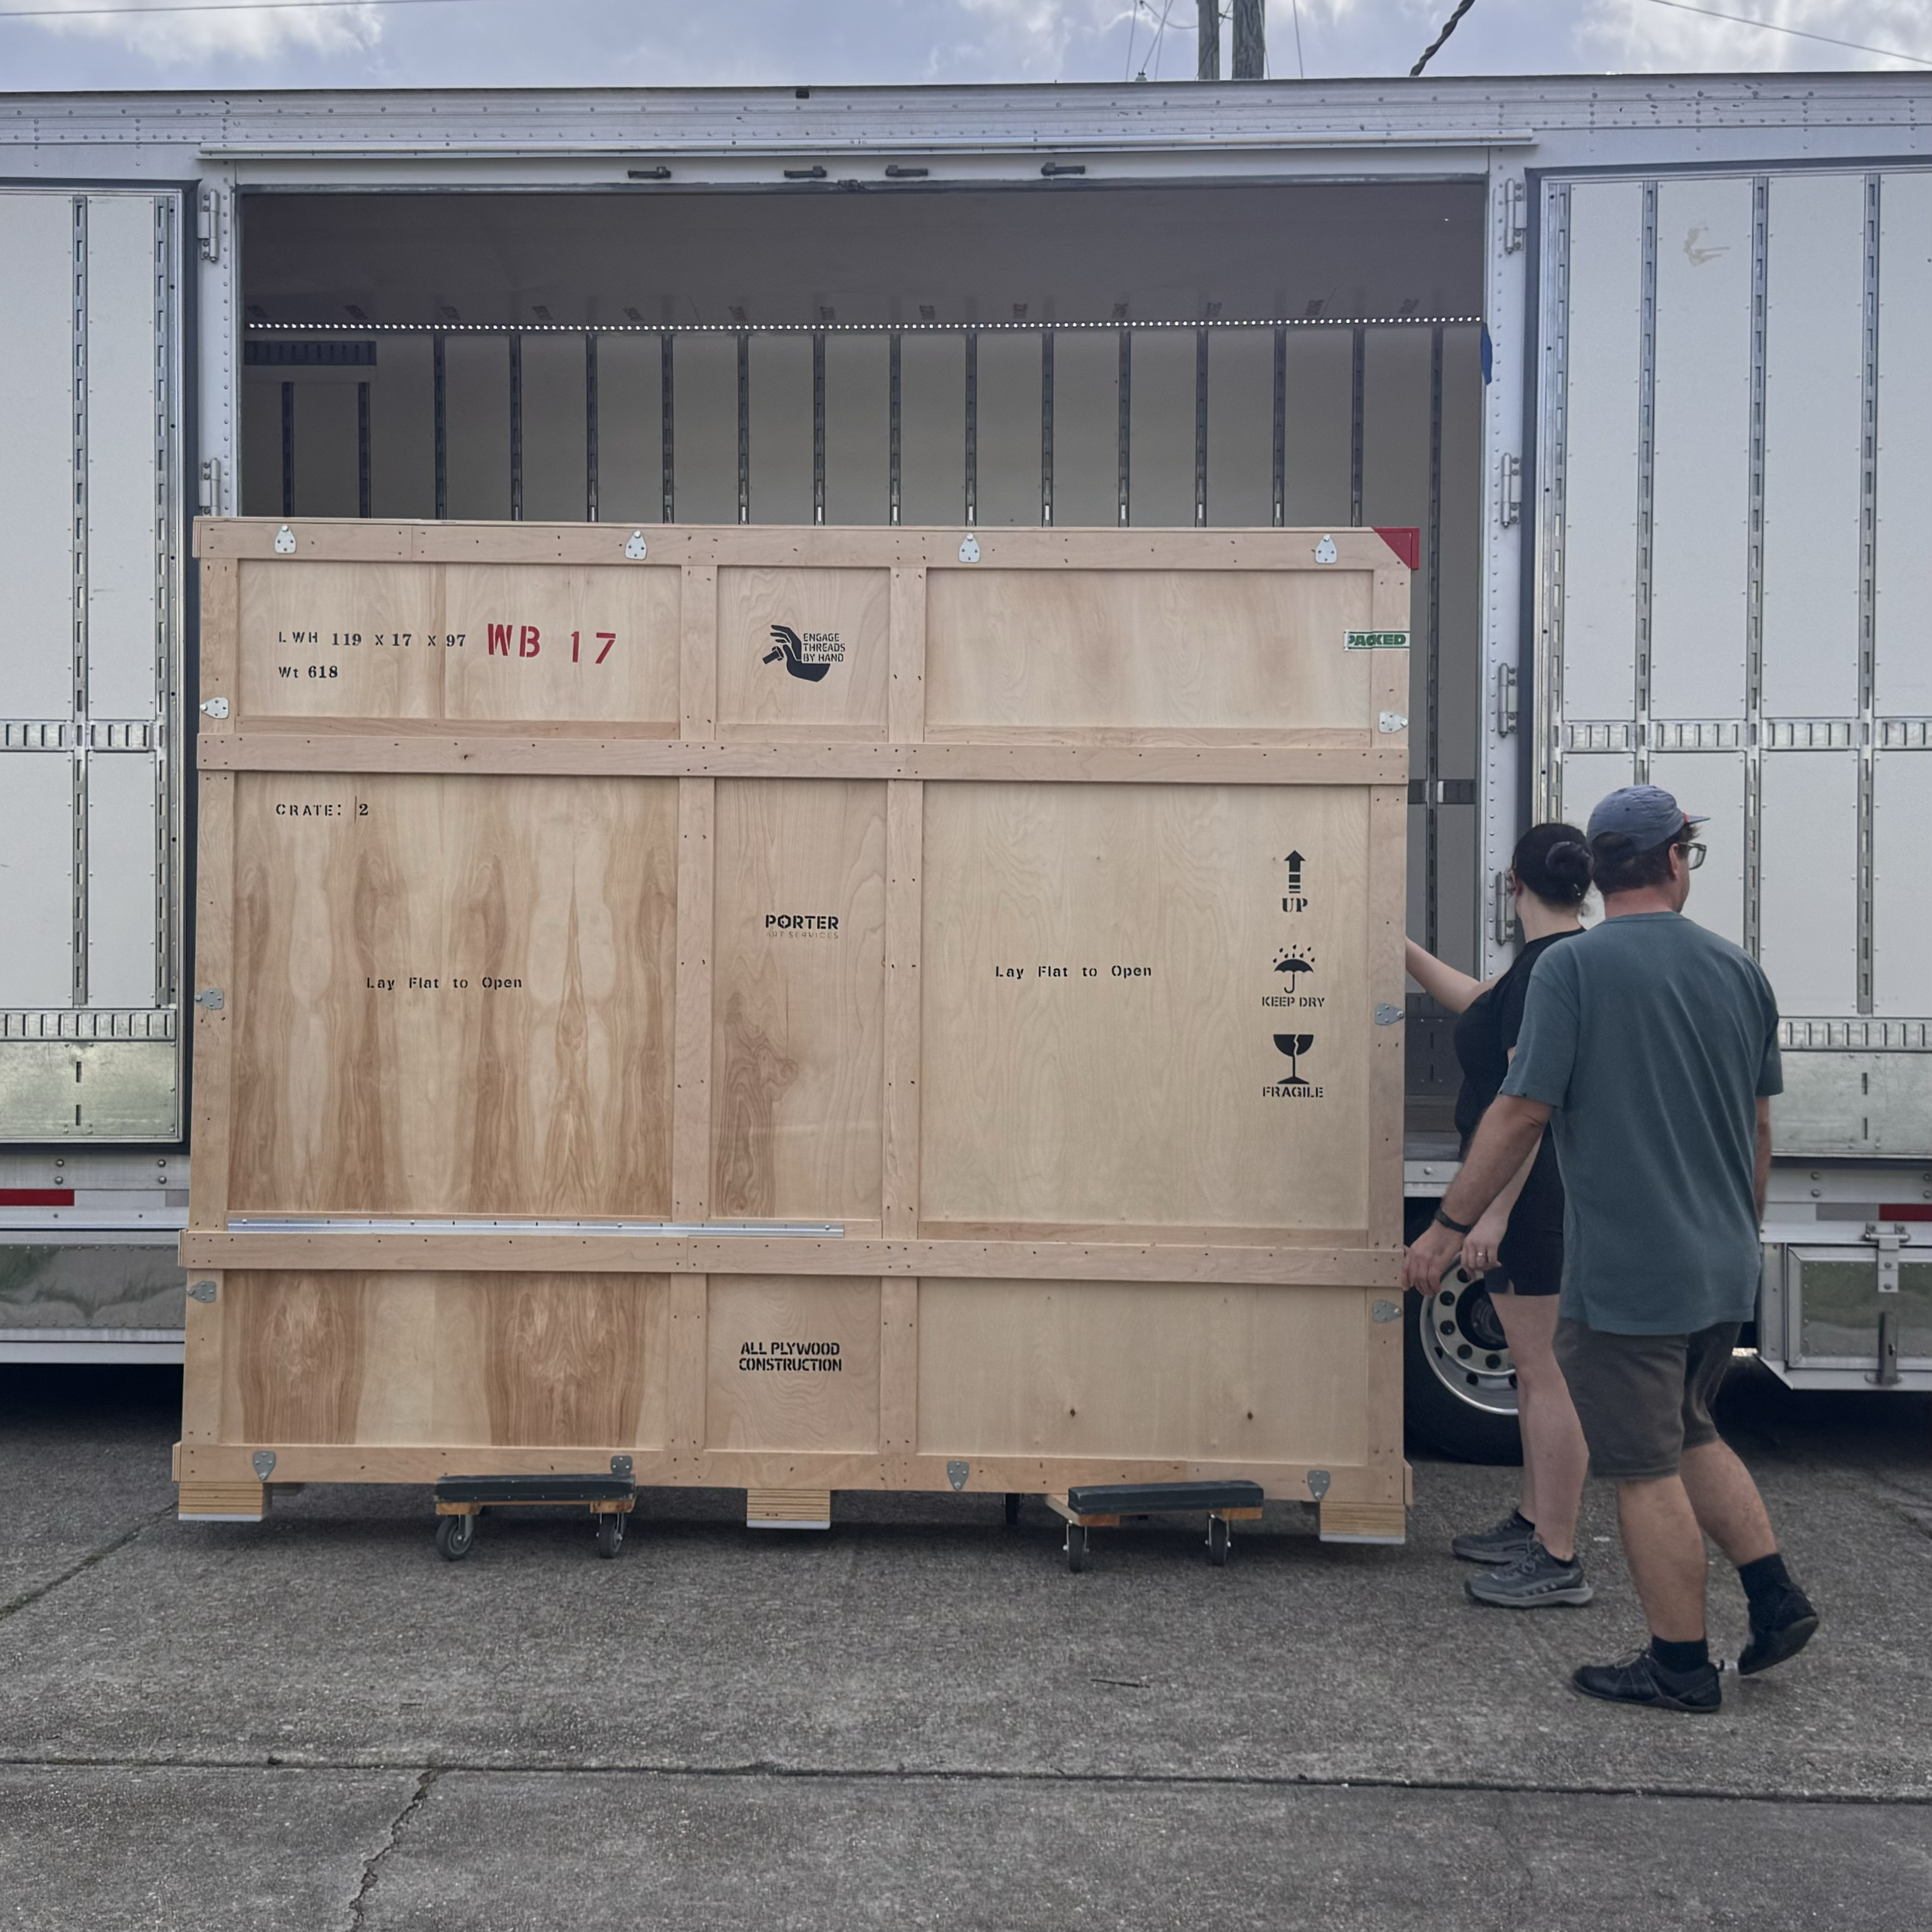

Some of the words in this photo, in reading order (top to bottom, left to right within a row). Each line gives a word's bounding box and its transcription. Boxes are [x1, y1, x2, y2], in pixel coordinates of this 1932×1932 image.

[278, 631, 318, 643] LWH
[332, 633, 362, 645] 119
[392, 634, 412, 646] 17
[446, 634, 466, 647] 97
[488, 624, 540, 658] WB
[571, 631, 616, 664] 17
[803, 633, 840, 642] ENGAGE
[803, 643, 845, 652] THREADS
[818, 654, 844, 662] HAND
[278, 666, 299, 679] Wt
[308, 665, 338, 679] 618
[276, 804, 341, 816] CRATE:
[359, 803, 369, 816] 2
[1282, 897, 1308, 913] UP
[765, 914, 839, 930] PORTER
[995, 966, 1024, 980] Lay
[1038, 966, 1068, 978] Flat
[1083, 967, 1097, 977] to
[1111, 965, 1151, 979] Open
[366, 977, 395, 991] Lay
[409, 977, 439, 989] Flat
[453, 978, 468, 988] to
[481, 977, 522, 991] Open
[1262, 996, 1295, 1007] KEEP
[1299, 997, 1325, 1008] DRY
[1262, 1087, 1324, 1098] FRAGILE
[740, 1342, 767, 1355] ALL
[770, 1342, 840, 1355] PLYWOOD
[739, 1358, 842, 1372] CONSTRUCTION
